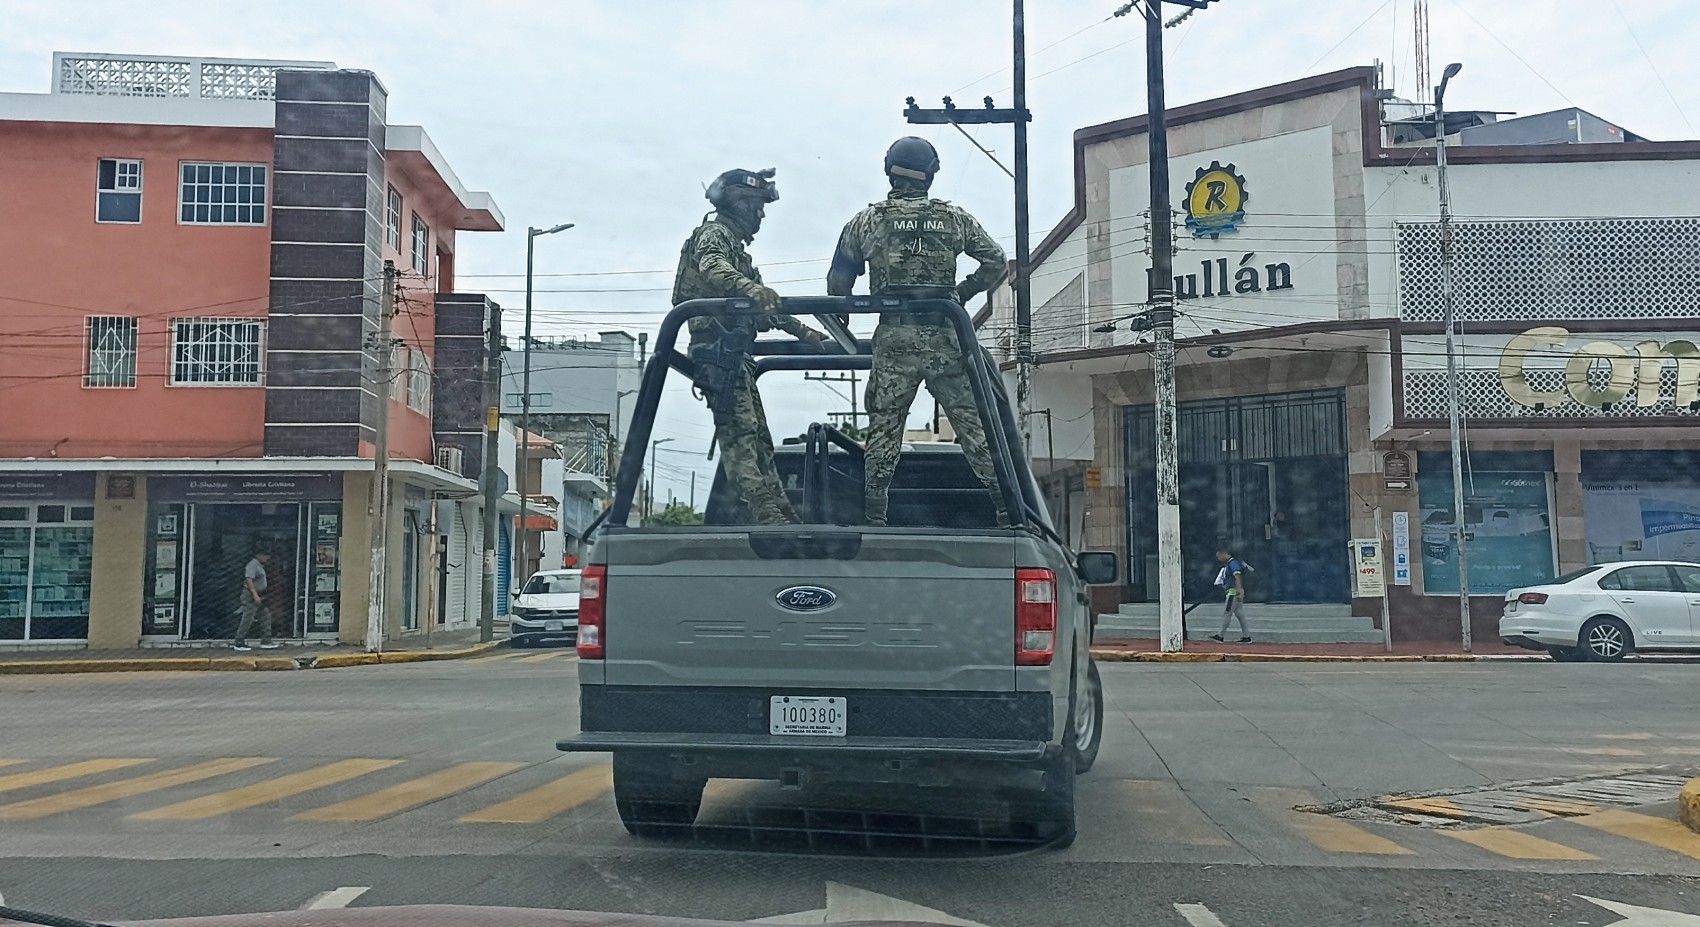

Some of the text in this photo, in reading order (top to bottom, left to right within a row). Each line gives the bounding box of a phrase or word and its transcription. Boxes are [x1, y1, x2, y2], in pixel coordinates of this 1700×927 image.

[1205, 181, 1227, 212] R
[1146, 252, 1294, 304] ullán
[790, 590, 822, 605] Ford
[782, 707, 836, 723] 100380
